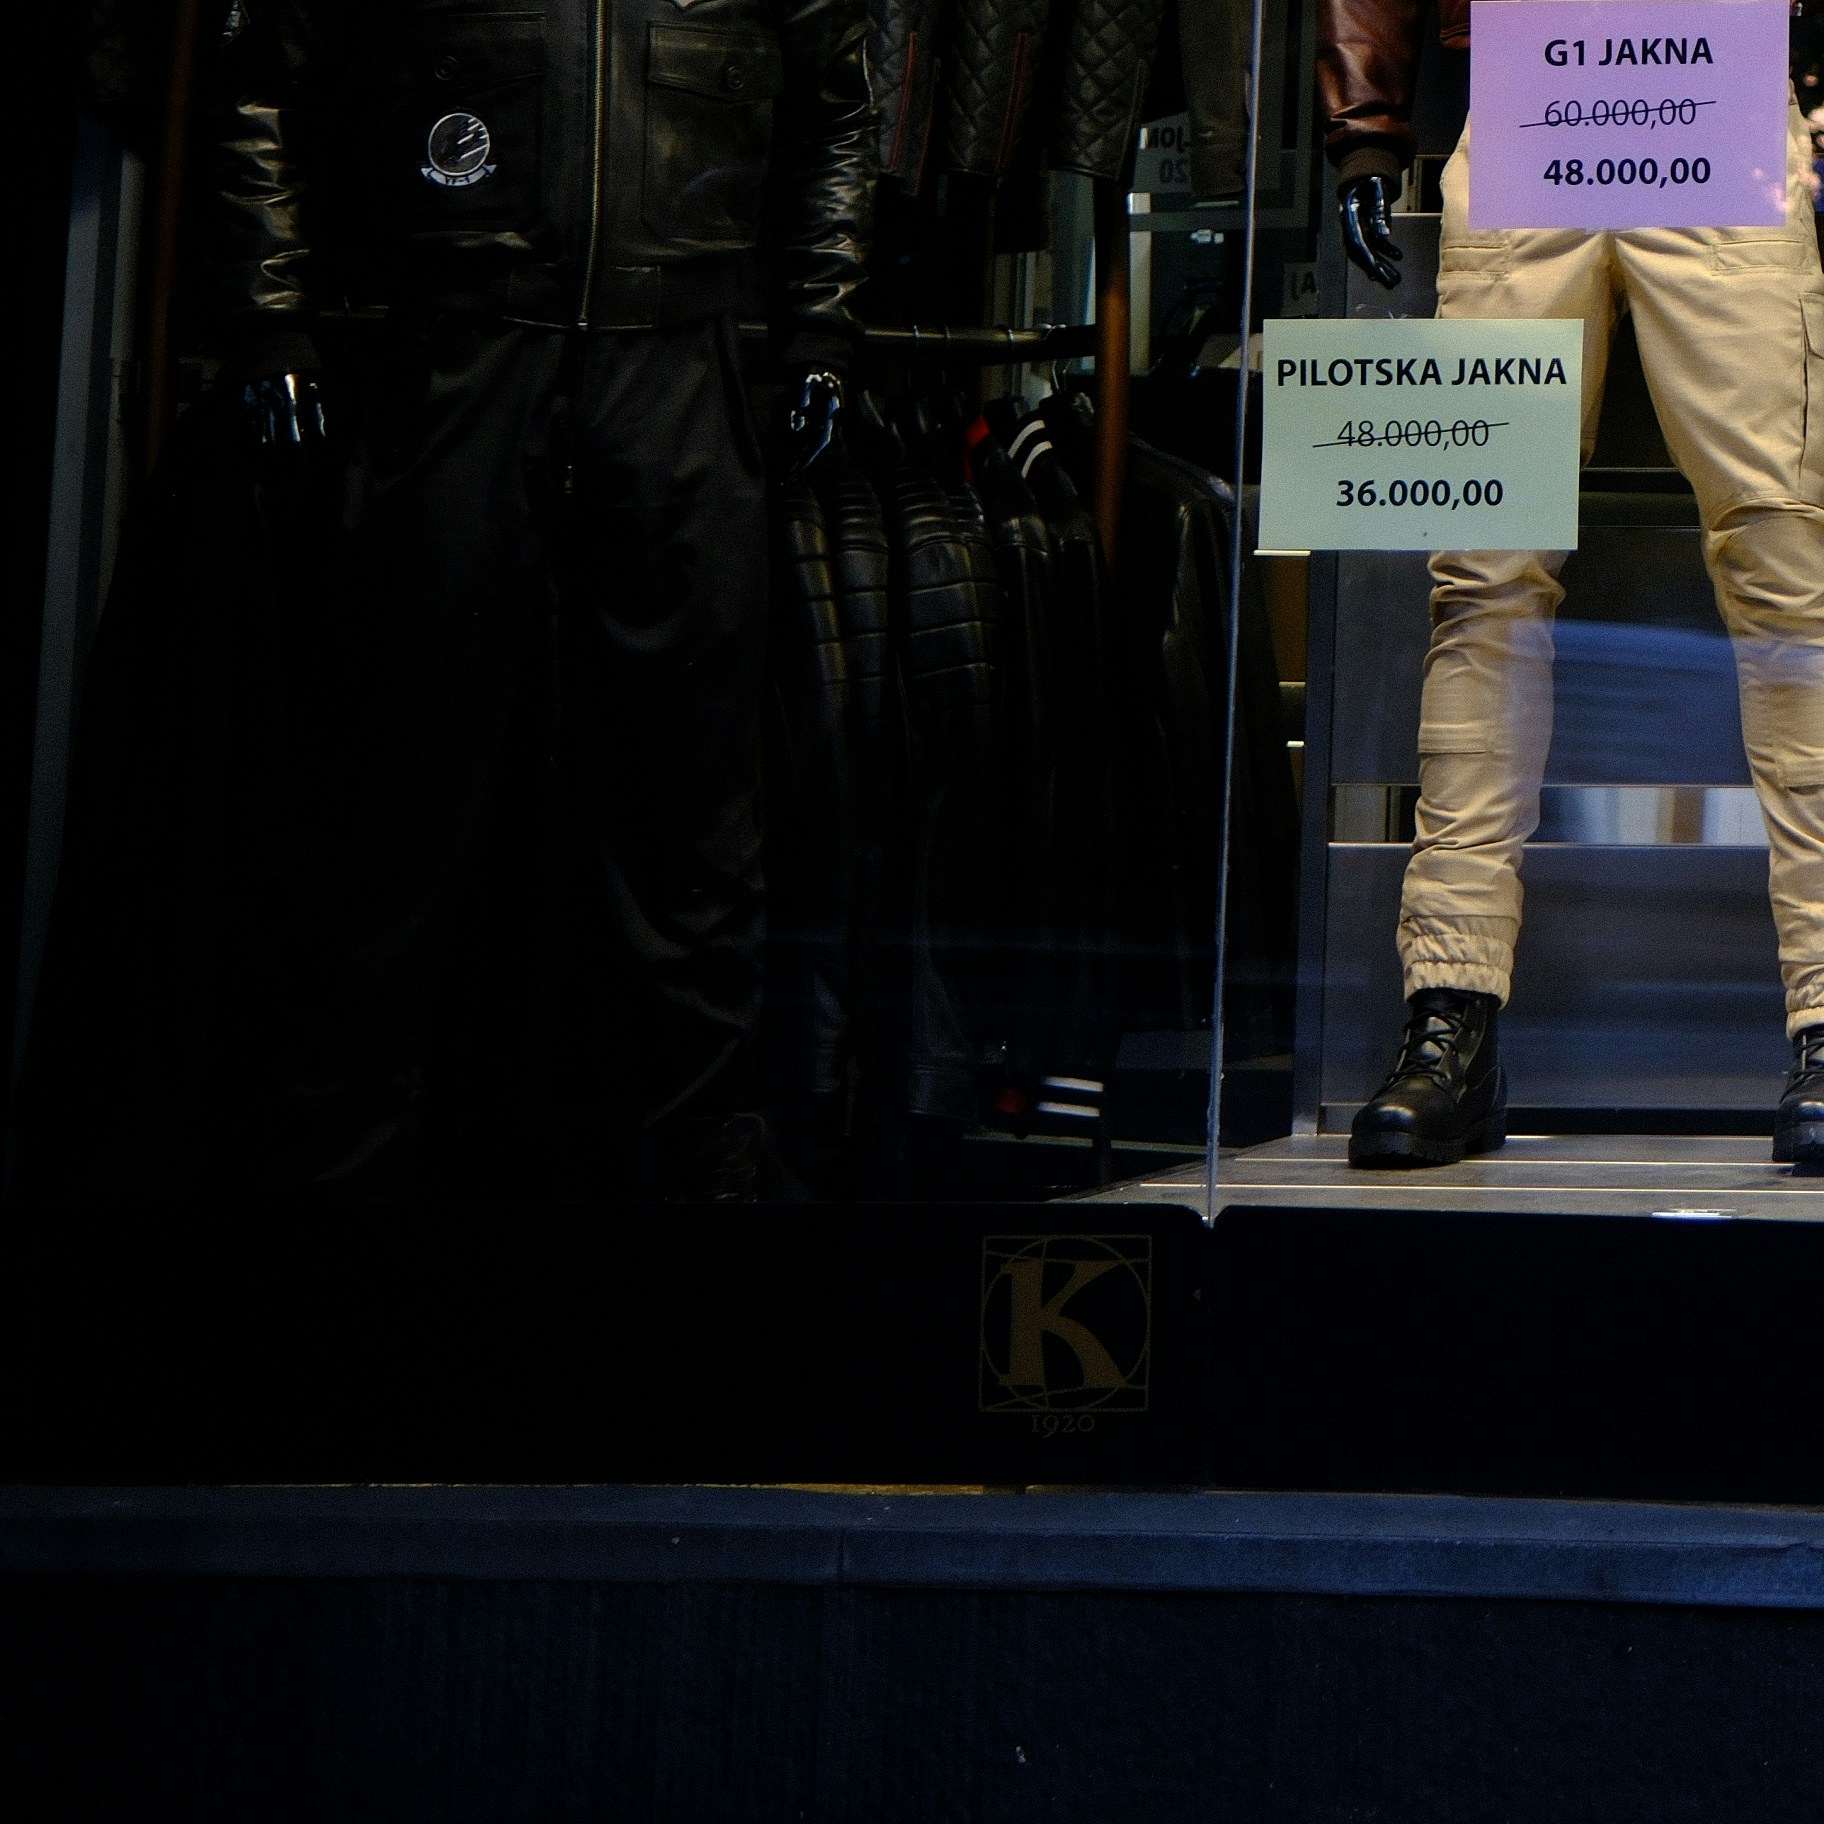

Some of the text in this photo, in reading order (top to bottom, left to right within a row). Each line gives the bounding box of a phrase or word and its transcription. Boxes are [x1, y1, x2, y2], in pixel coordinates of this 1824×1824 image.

[1544, 37, 1714, 66] G1 JAKNA
[1545, 98, 1697, 130] 60.000,00
[1543, 157, 1711, 189] 48.000,00
[1277, 357, 1567, 387] PILOTSKA JAKNA
[1337, 419, 1490, 451] 48.000,00
[1336, 479, 1503, 511] 36.000,00
[998, 1259, 1129, 1388] K
[1031, 1414, 1097, 1439] 1920
